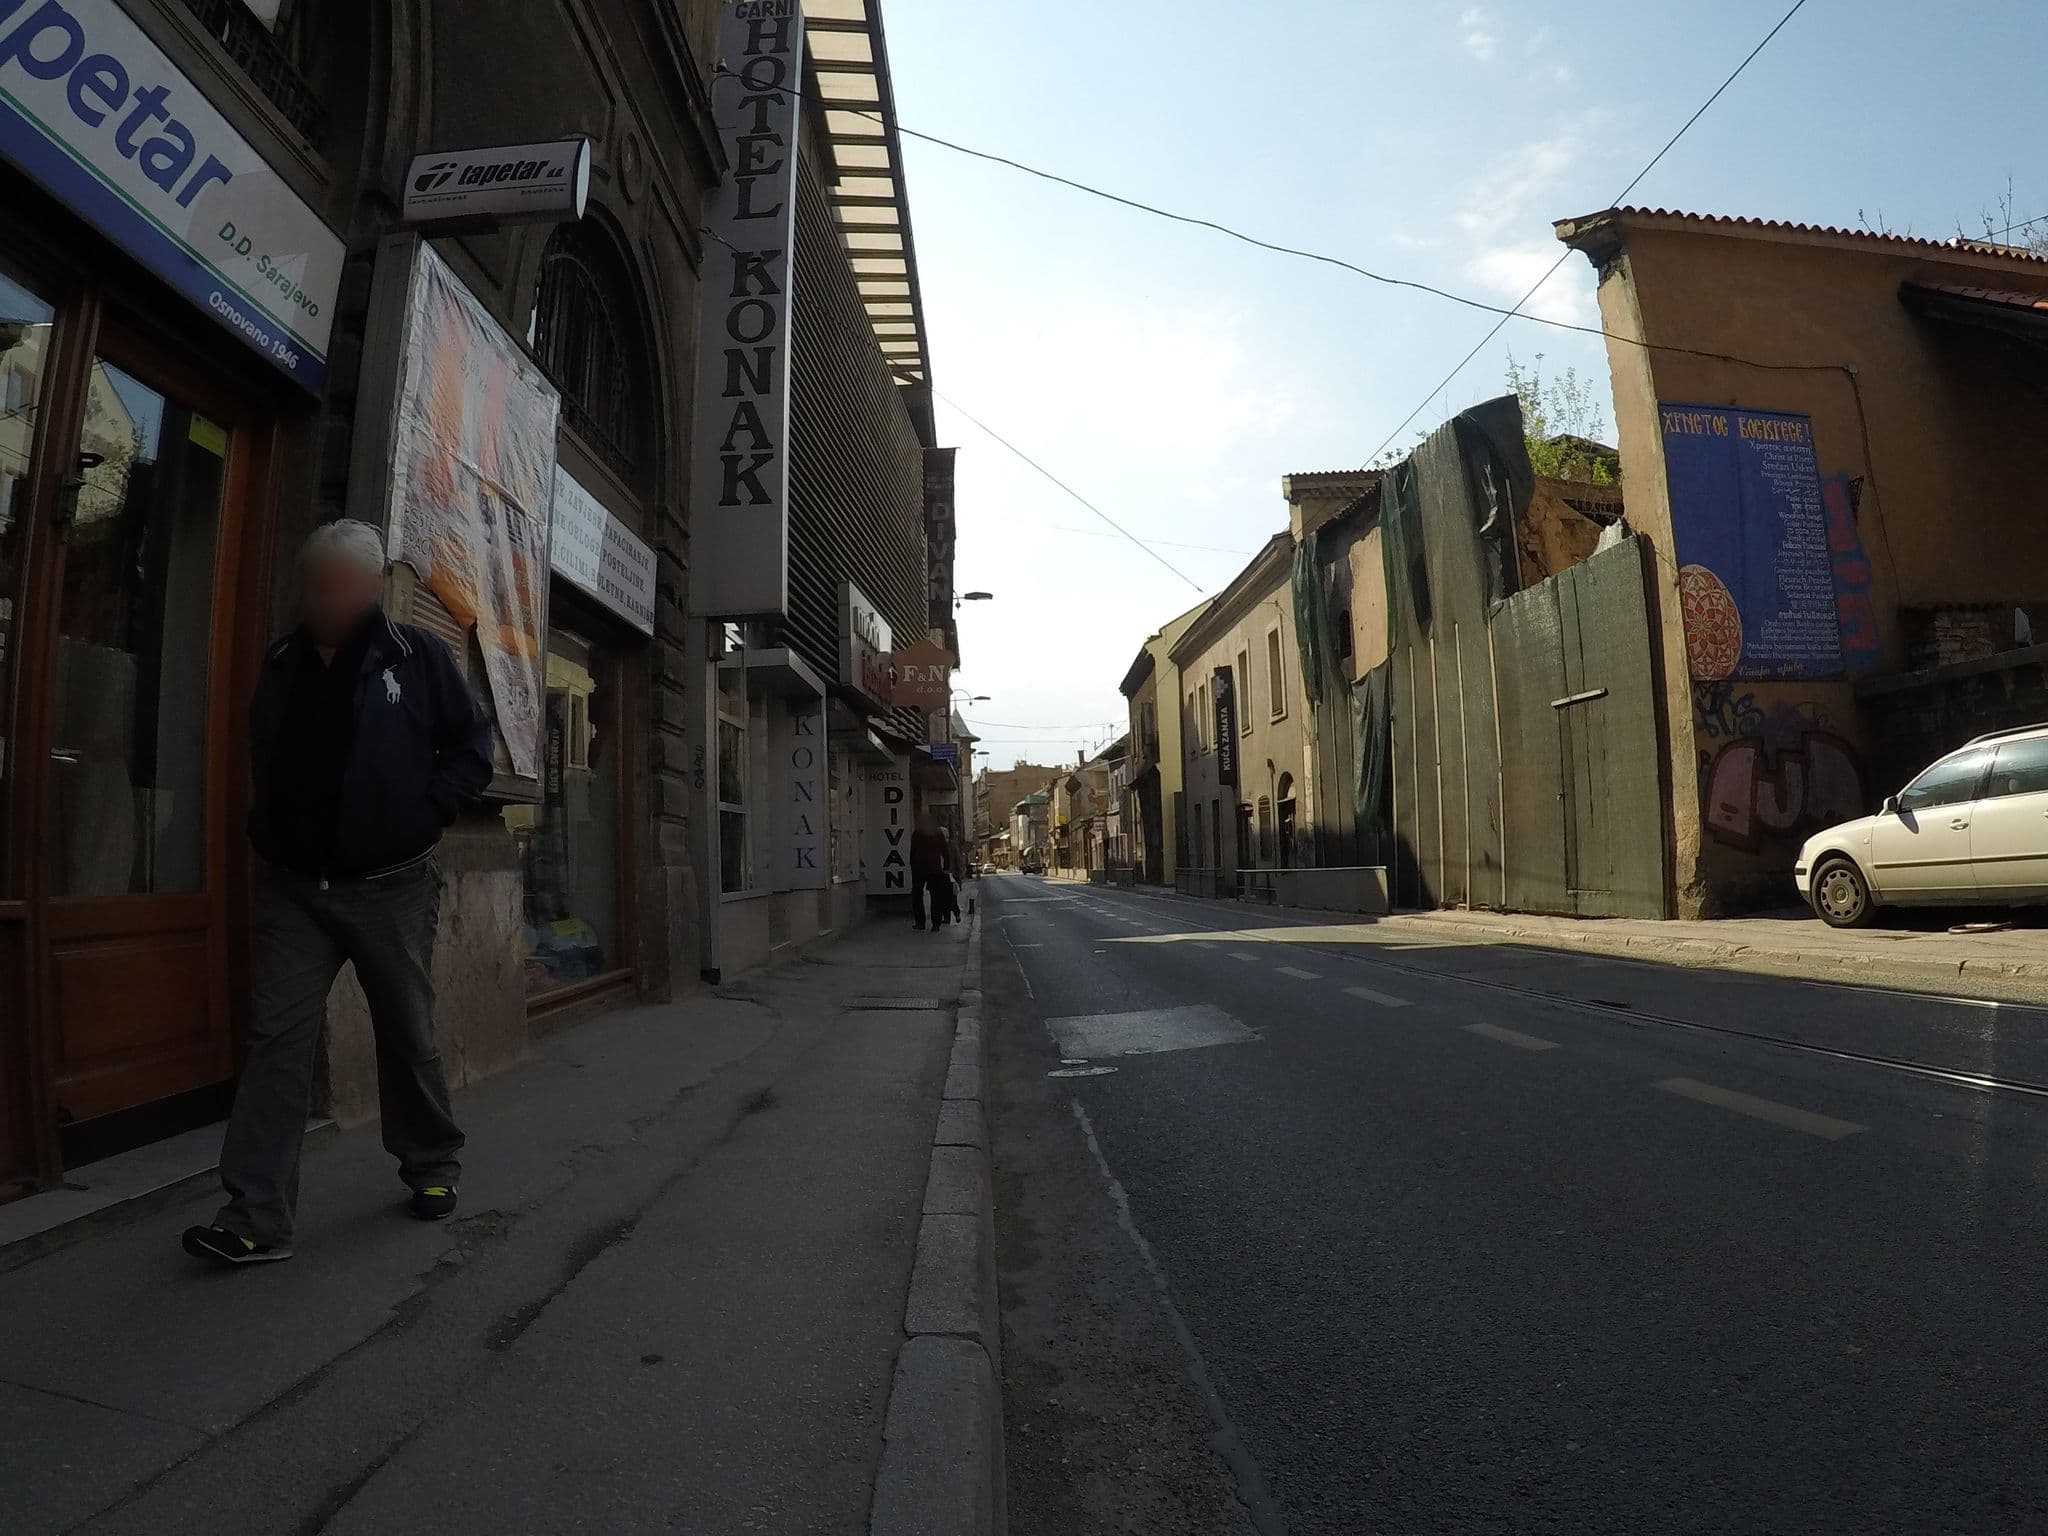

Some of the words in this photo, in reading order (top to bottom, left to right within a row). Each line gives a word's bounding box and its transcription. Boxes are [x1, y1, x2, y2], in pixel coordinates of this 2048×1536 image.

[733, 18, 792, 220] HOTEL
[458, 160, 550, 186] tapetar
[218, 221, 253, 261] D.D.
[257, 255, 319, 317] Sarajevo
[208, 291, 270, 347] Osnovano
[272, 340, 300, 369] 1946
[718, 250, 782, 507] KONAK
[791, 714, 817, 869] KONAK
[870, 772, 904, 782] HOTEL
[883, 786, 906, 889] DIVAN
